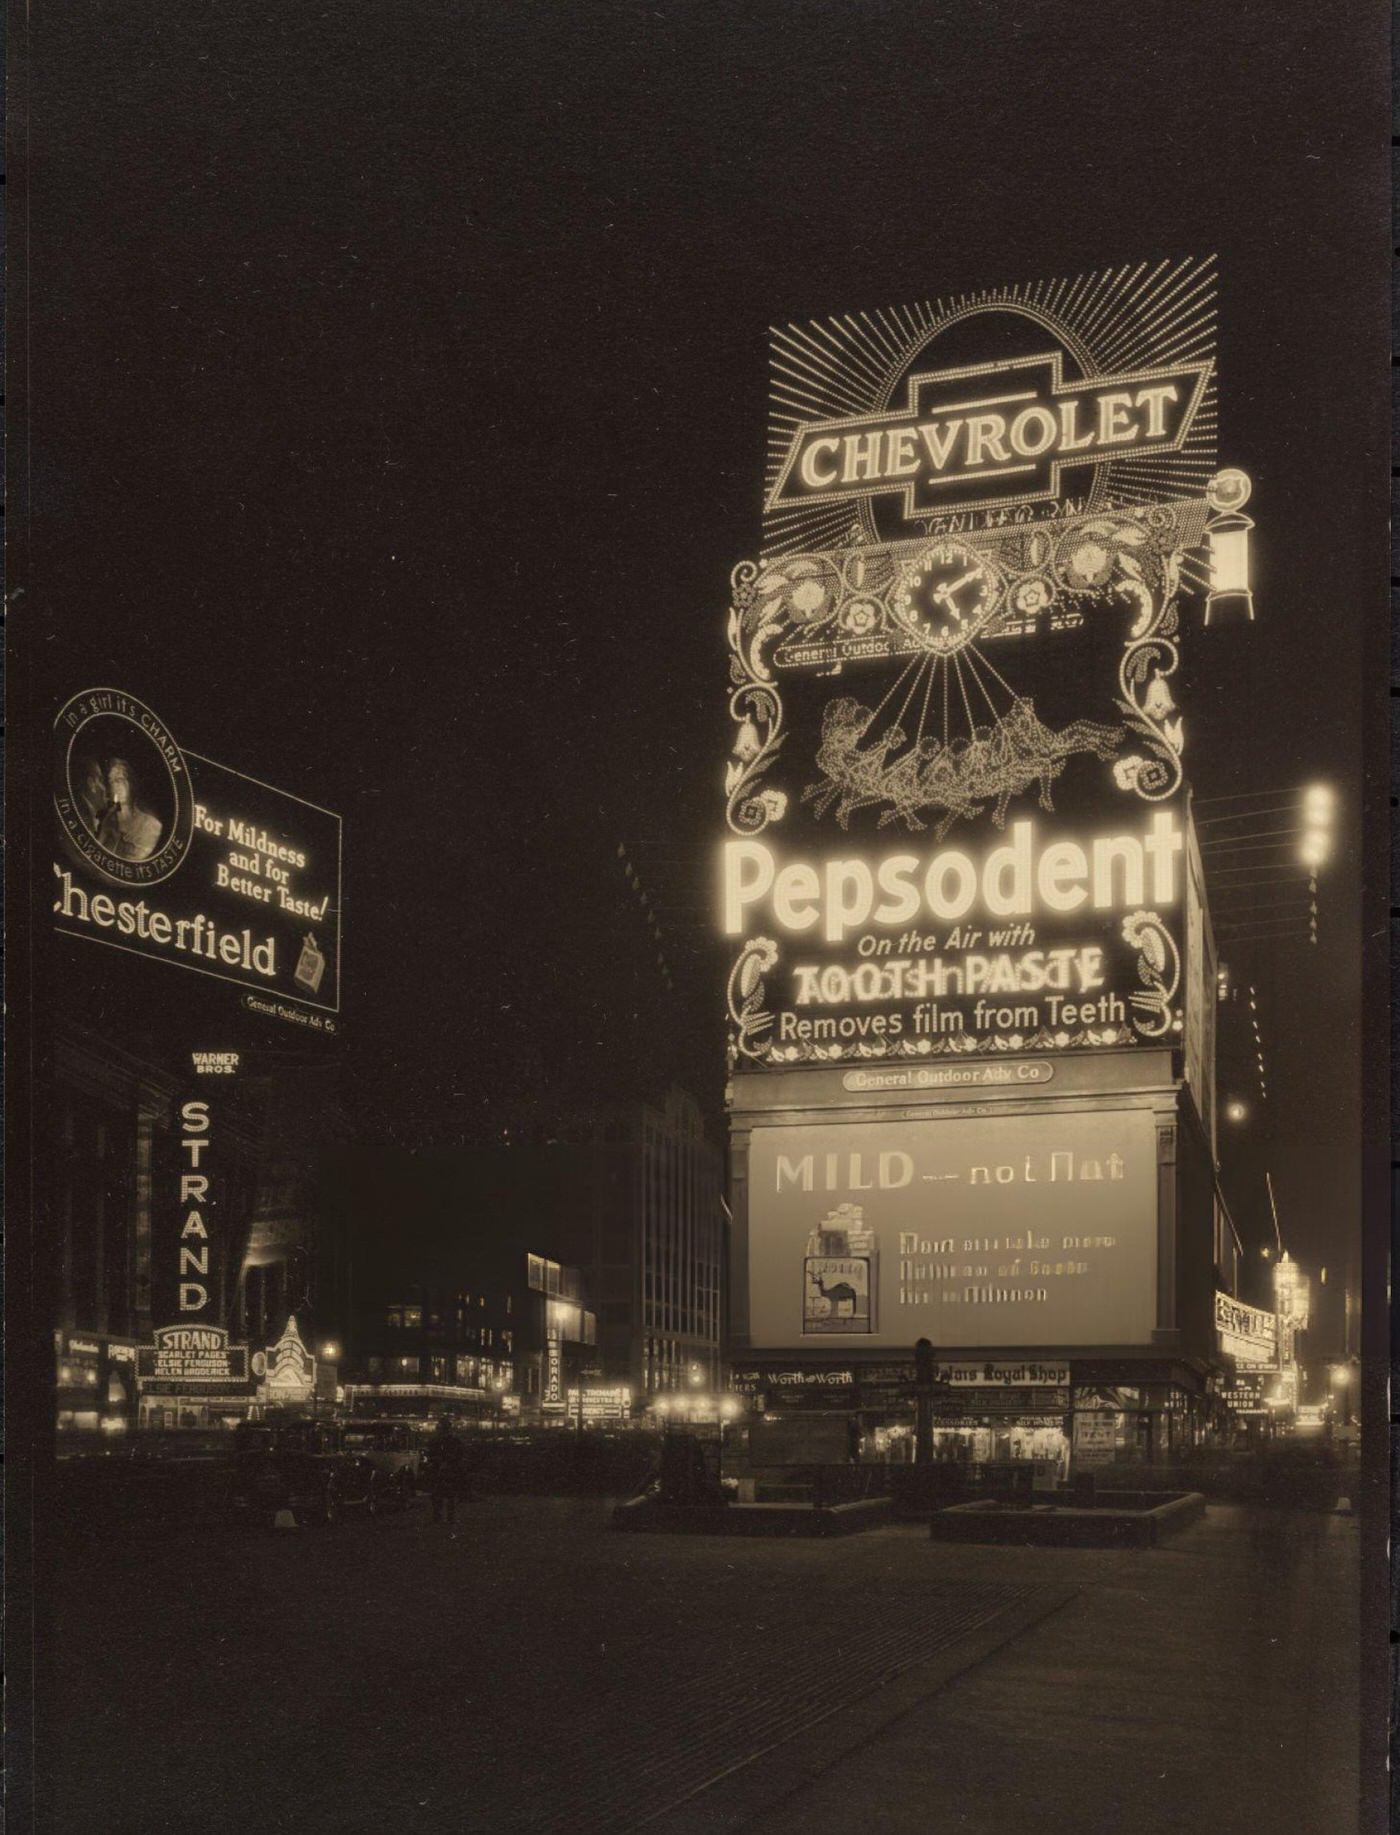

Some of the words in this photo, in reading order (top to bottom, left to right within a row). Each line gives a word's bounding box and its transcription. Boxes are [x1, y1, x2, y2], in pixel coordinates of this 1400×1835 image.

[800, 386, 1178, 488] CHEVROLET
[141, 713, 182, 772] CHARM
[154, 836, 184, 875] TASTE
[194, 804, 223, 836] For
[227, 818, 306, 869] Mildness
[229, 852, 260, 876] and
[265, 859, 290, 885] for
[724, 812, 1183, 942] Pepsodent
[217, 863, 272, 903] Better
[276, 886, 329, 922] Taste!
[54, 862, 278, 976] hesterfield
[858, 934, 892, 956] On
[899, 930, 936, 954] the
[945, 926, 980, 950] Air
[988, 923, 1036, 948] with
[780, 1009, 902, 1041] Removes
[913, 1005, 964, 1034] film
[974, 1002, 1038, 1030] from
[1048, 993, 1126, 1026] Teeth
[192, 1052, 239, 1066] WARNER
[856, 1070, 912, 1088] General
[917, 1067, 979, 1086] Outdoor
[1018, 1064, 1040, 1081] Co
[777, 1150, 915, 1192] MILD
[180, 1101, 211, 1312] STRAND
[163, 1330, 221, 1350] STRAND
[768, 1371, 804, 1384] Worth
[816, 1370, 853, 1384] Worth
[983, 1363, 1026, 1385] Royal
[1029, 1363, 1067, 1384] Shop
[1221, 1391, 1261, 1399] WESTERN
[1227, 1400, 1254, 1408] UNION
